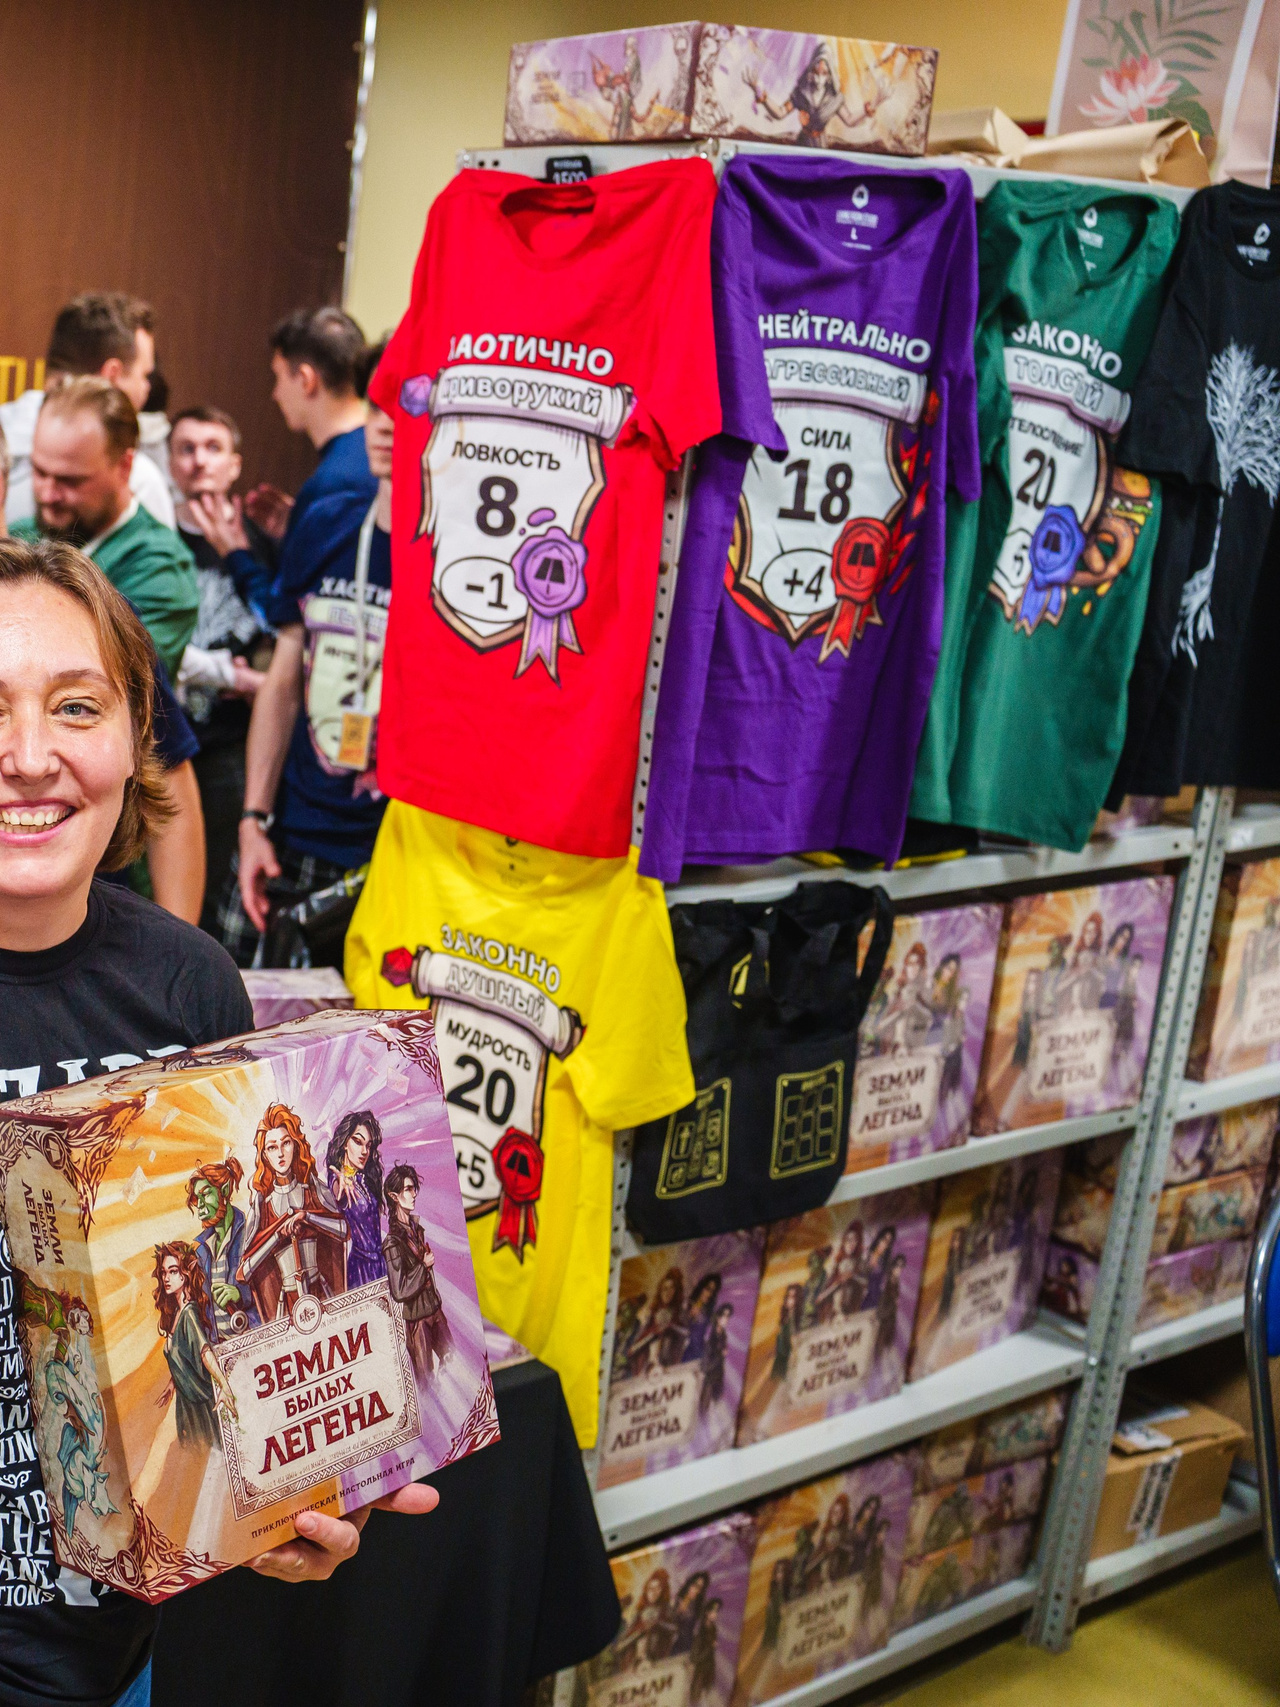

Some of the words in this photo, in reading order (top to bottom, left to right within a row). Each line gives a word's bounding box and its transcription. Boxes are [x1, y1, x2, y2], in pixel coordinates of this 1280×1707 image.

[758, 308, 931, 364] НЕЙТРАЛЬНО
[442, 376, 602, 417] риворукий
[452, 441, 561, 471] ЛОВКОСТЬ
[801, 427, 851, 451] СИЛА
[778, 458, 853, 525] 18
[1016, 448, 1056, 511] 20
[475, 476, 519, 536] 8
[319, 576, 392, 608] ХАОТИ
[466, 572, 508, 610] -1
[783, 565, 826, 603] +4
[441, 923, 560, 994] ЗАКОННО
[445, 963, 546, 1028] ДУШНЫЙ
[446, 1019, 531, 1071] МУДРОСТЬ
[447, 1054, 516, 1126] 20
[867, 1066, 926, 1095] ЗЕМЛИ
[859, 1103, 922, 1134] ЛЕГЕНД
[21, 1179, 45, 1266] ЛЕГЕНД
[37, 1202, 50, 1248] БЫЛЫХ
[42, 1188, 65, 1266] ЗЕМЛИ
[253, 1321, 373, 1400] ЗЕМЛИ
[284, 1372, 356, 1419] БЫЛЫХ
[620, 1381, 685, 1415] ЗЕМЛИ
[258, 1391, 394, 1475] ЛЕГЕНД
[610, 1417, 681, 1453] ЛЕГЕНД
[339, 1467, 393, 1499] НАСТОЛЬНАЯ
[395, 1457, 416, 1473] ИГРА
